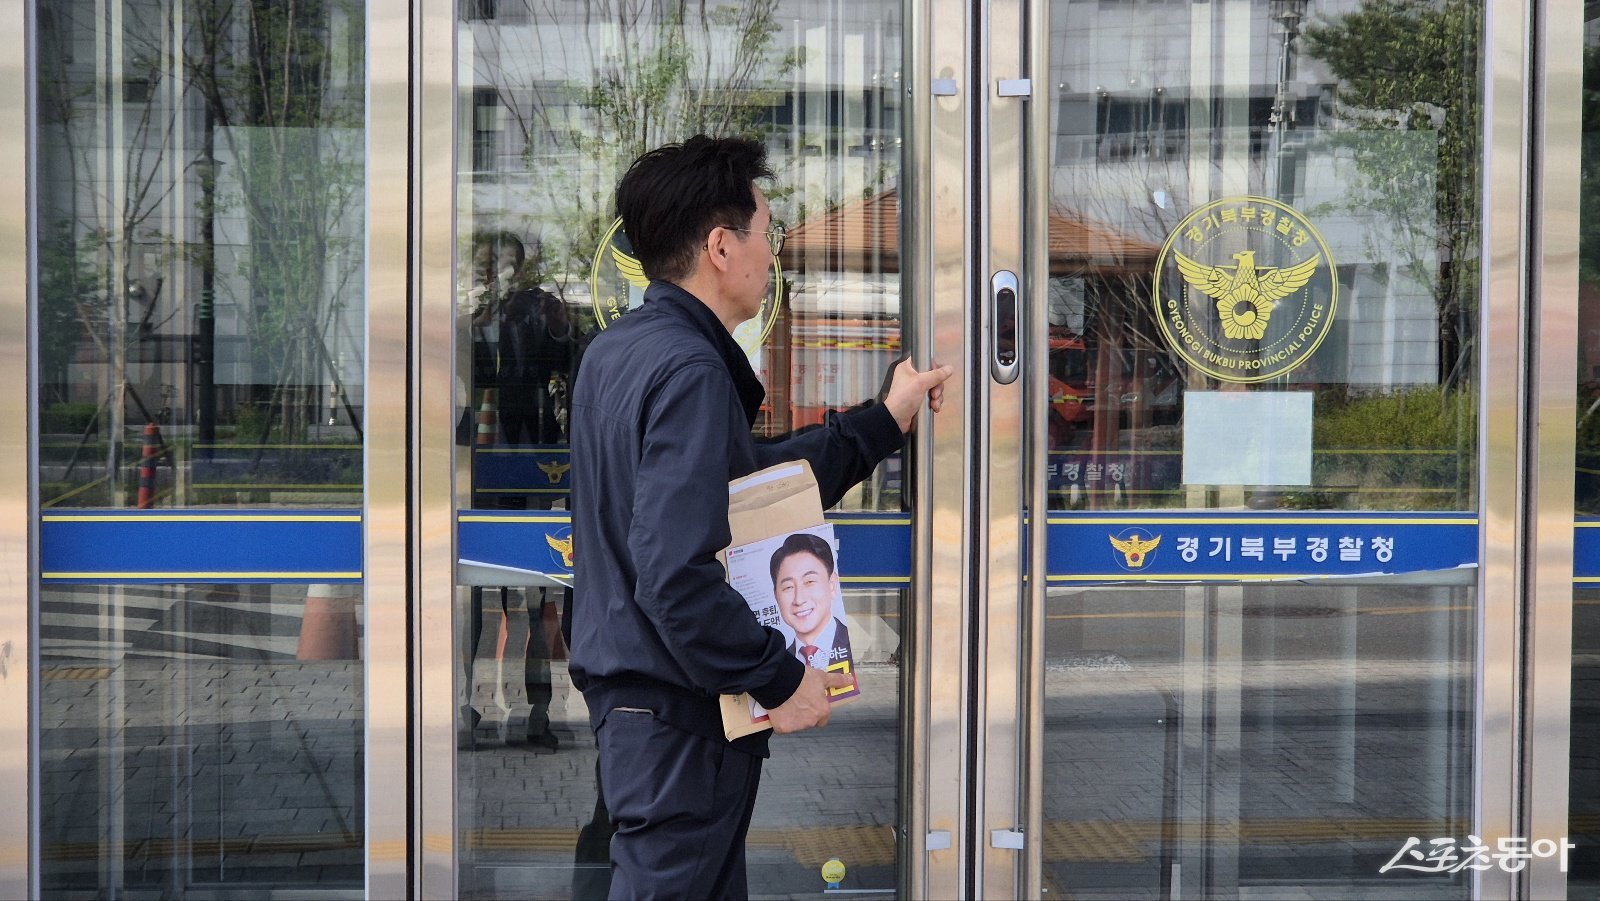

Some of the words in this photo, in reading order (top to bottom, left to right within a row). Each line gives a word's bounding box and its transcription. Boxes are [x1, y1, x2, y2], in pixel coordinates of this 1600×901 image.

[1184, 206, 1310, 247] 경기북부경찰청
[1167, 299, 1204, 355] GYEONGGI
[1202, 350, 1236, 369] BUKBU
[1238, 341, 1302, 370] PROVINCIAL
[1299, 303, 1324, 343] POLICE
[1175, 535, 1395, 563] 경기북부경찰청
